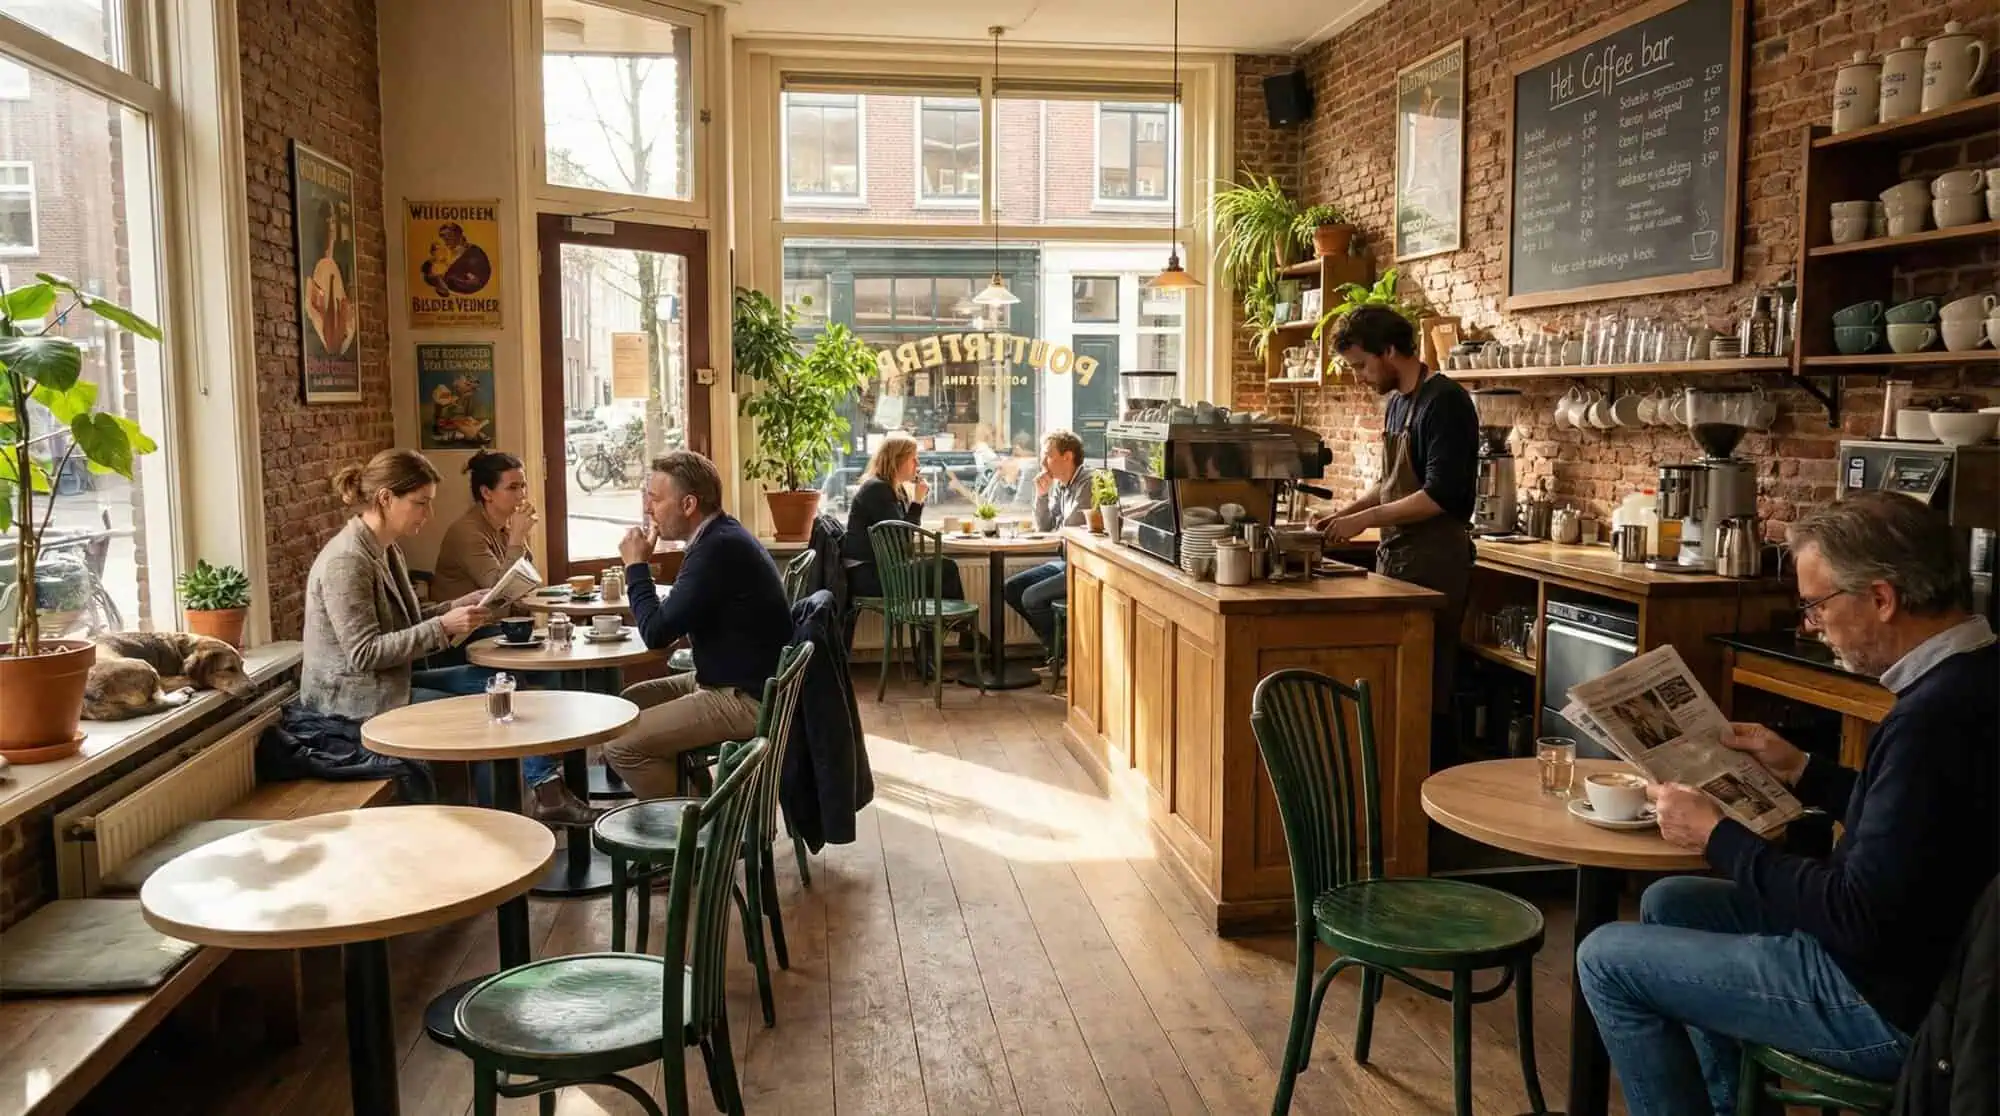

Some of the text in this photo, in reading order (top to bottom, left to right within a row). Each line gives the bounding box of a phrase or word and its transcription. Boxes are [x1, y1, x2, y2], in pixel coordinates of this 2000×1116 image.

[1550, 62, 1574, 102] Het
[1582, 45, 1634, 98] Coffee
[1642, 30, 1675, 68] bar
